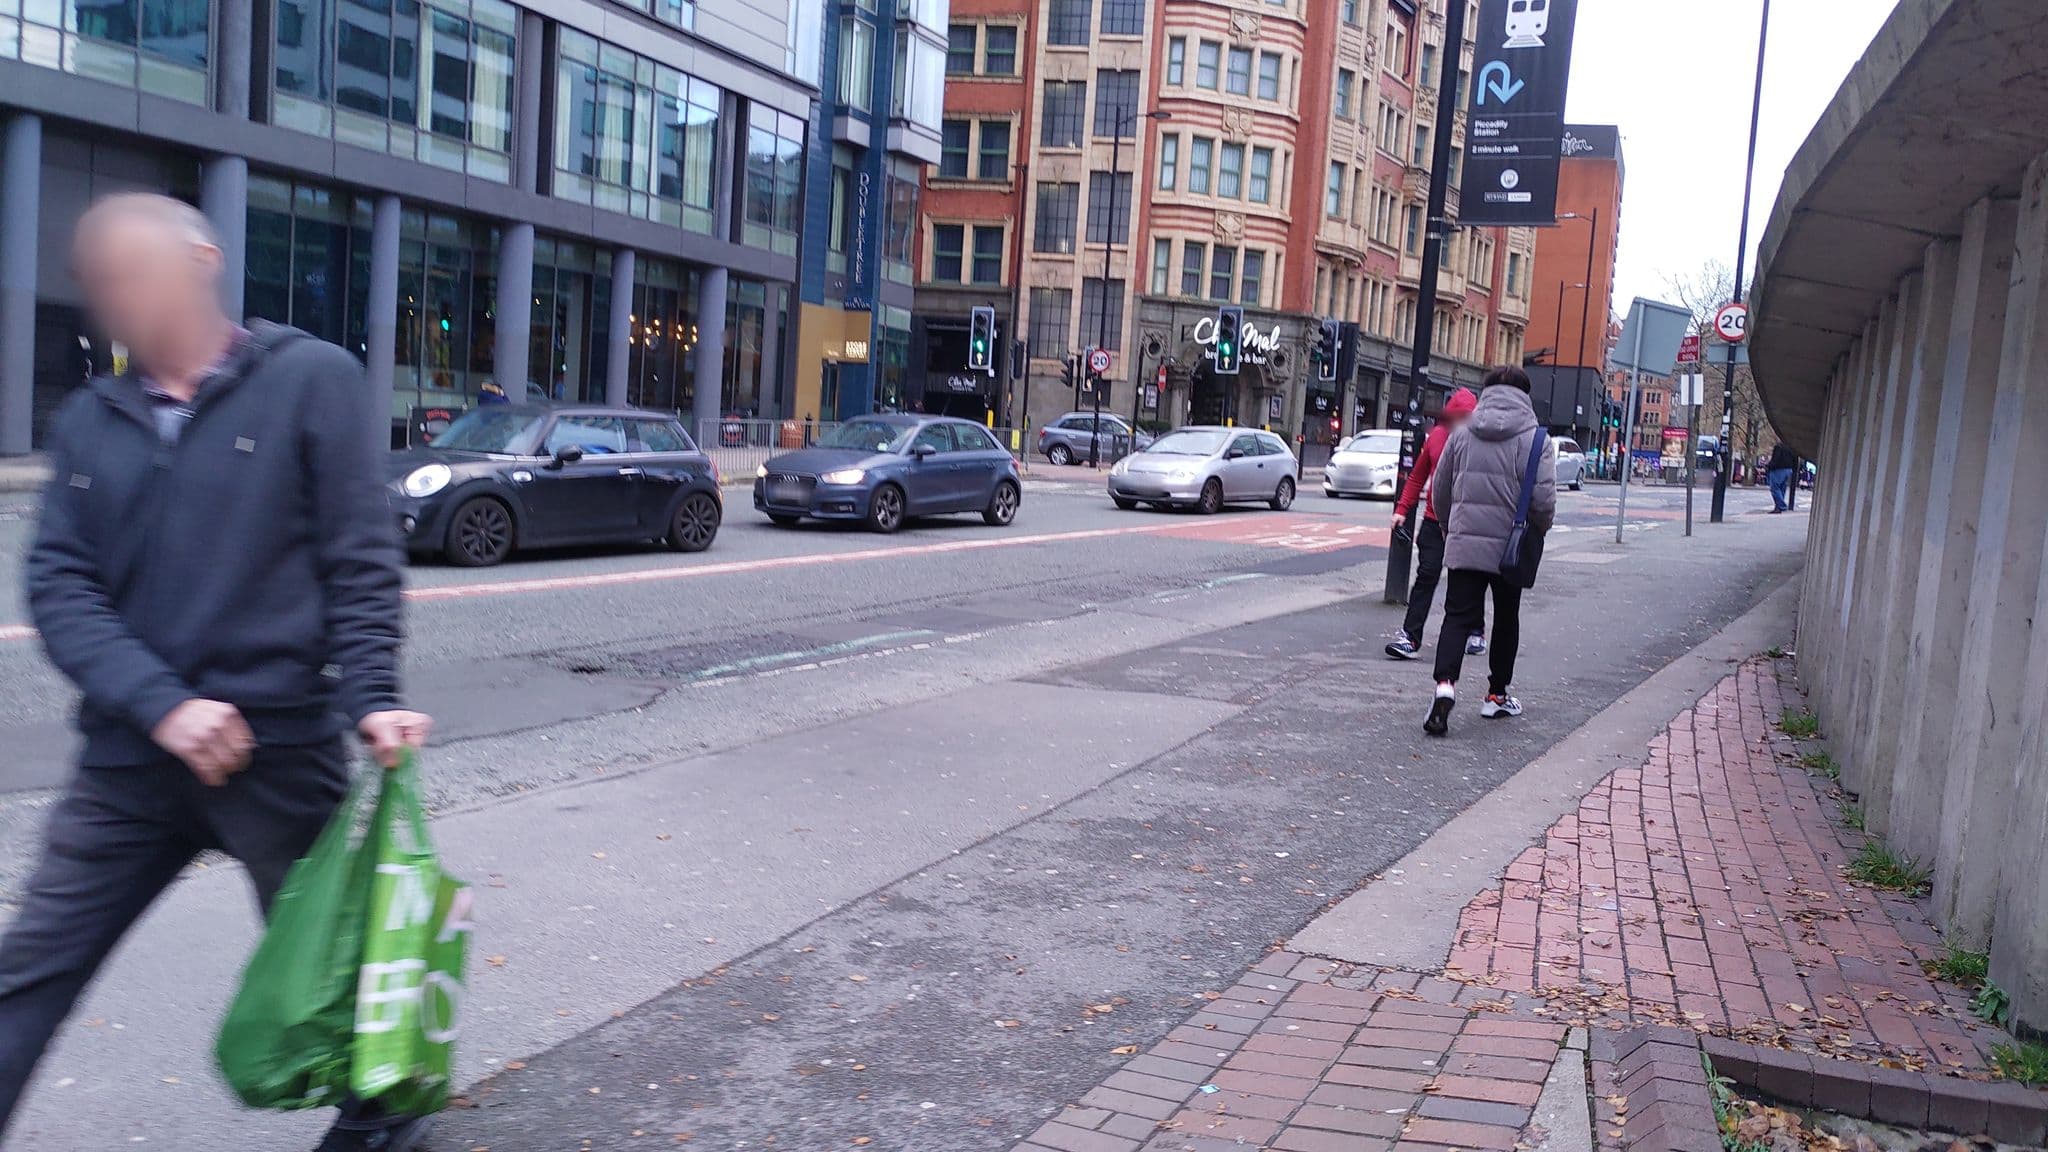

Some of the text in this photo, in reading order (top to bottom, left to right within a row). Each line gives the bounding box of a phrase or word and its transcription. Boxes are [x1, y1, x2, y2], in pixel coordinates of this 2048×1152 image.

[1474, 120, 1508, 129] Piccadilly
[1472, 145, 1519, 153] 2 minute walk
[1242, 322, 1280, 353] Mal
[1093, 355, 1107, 366] 20
[1252, 353, 1267, 365] bar
